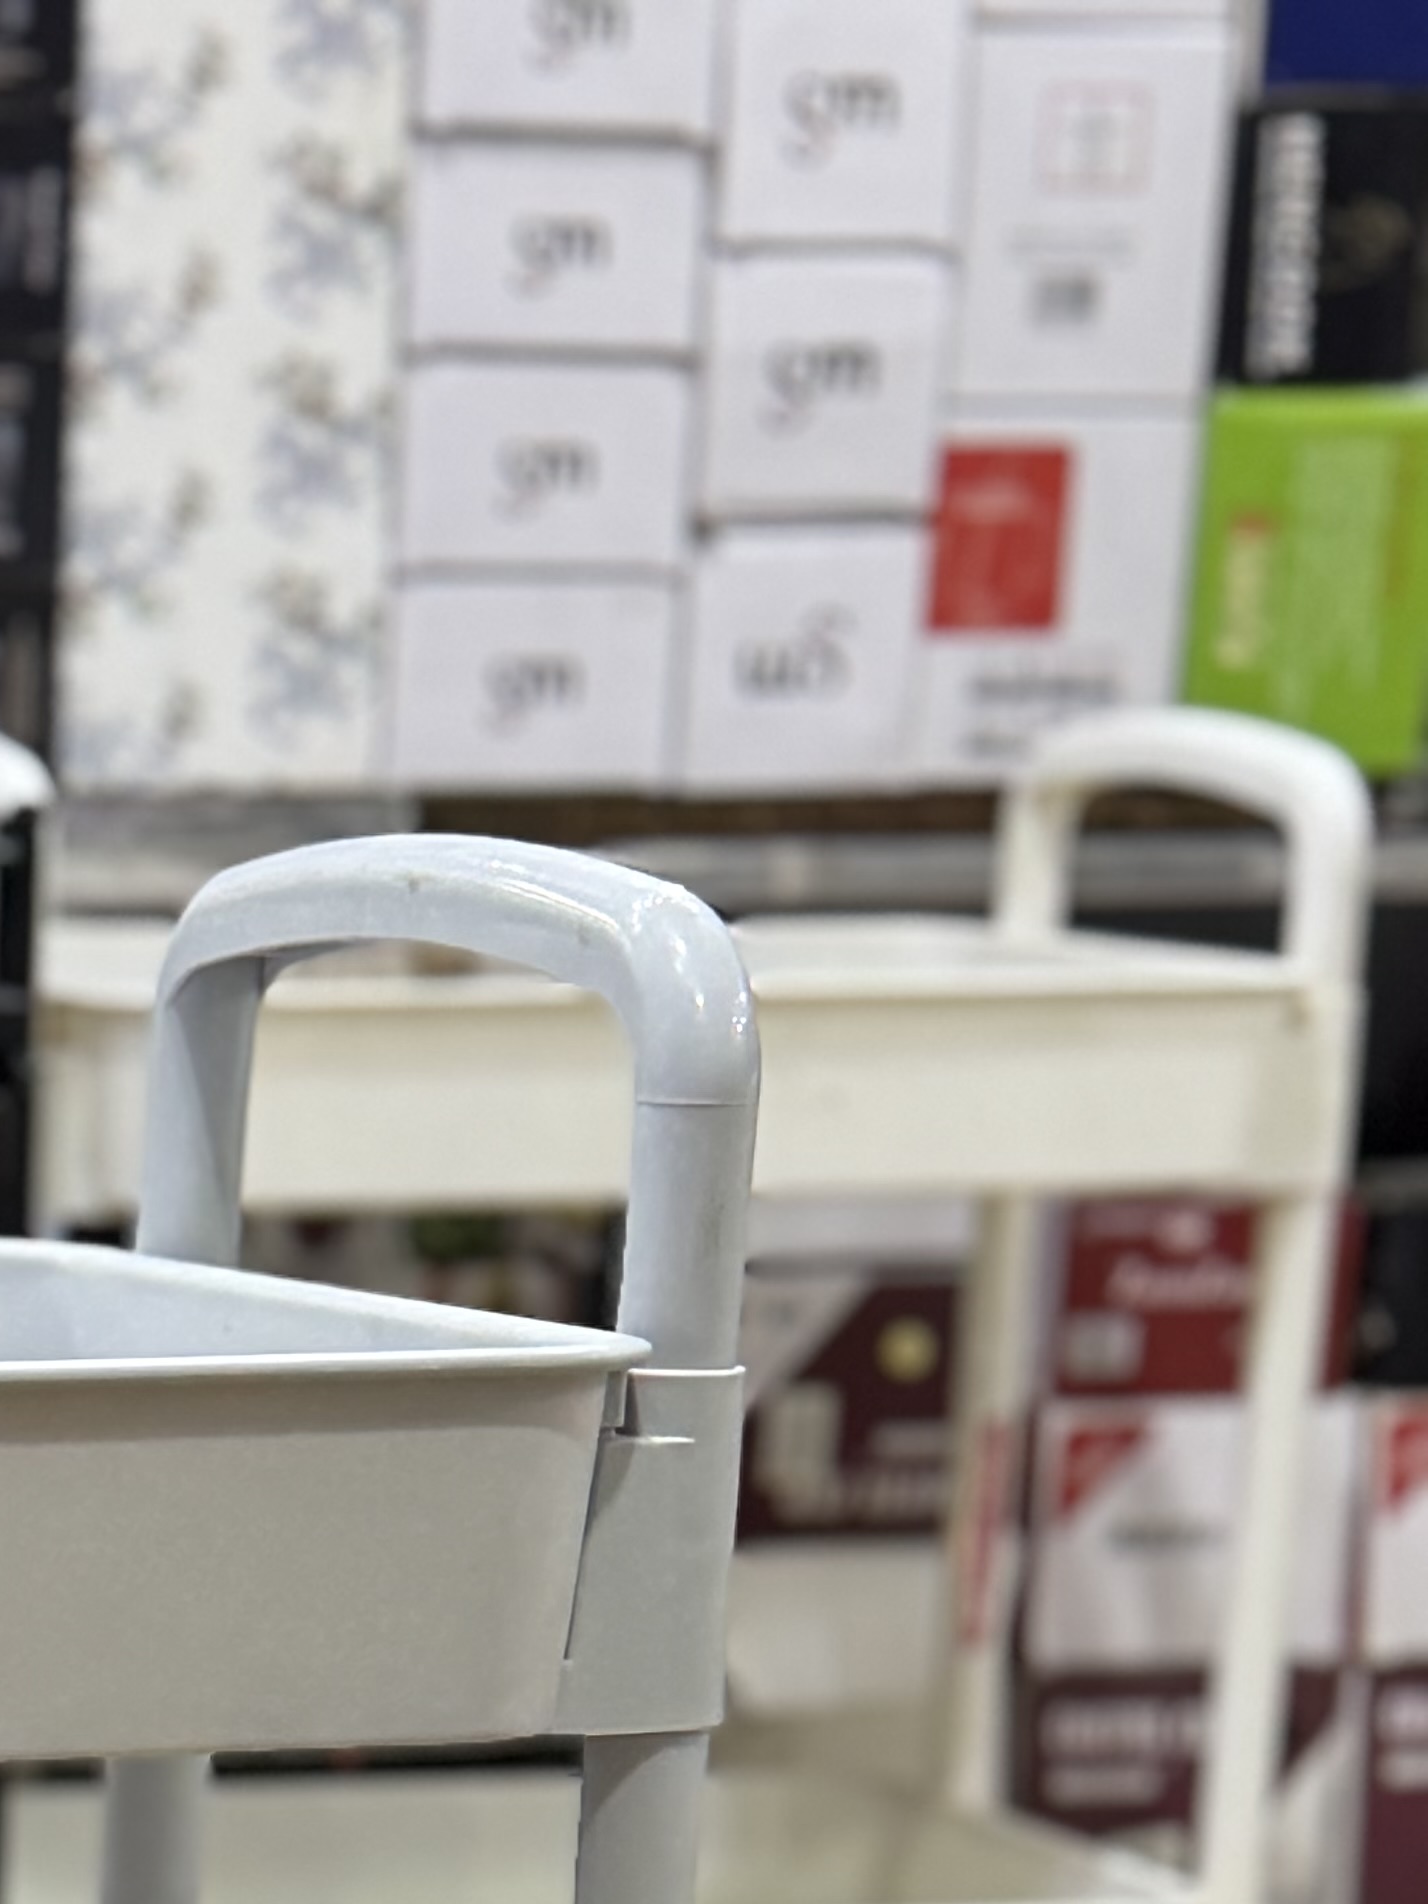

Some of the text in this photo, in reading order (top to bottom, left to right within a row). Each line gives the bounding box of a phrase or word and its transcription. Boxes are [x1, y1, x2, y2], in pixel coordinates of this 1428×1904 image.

[780, 68, 904, 172] gm
[505, 213, 615, 302] gm
[757, 338, 886, 440] gm
[491, 435, 601, 524] gm
[480, 650, 588, 739] gm
